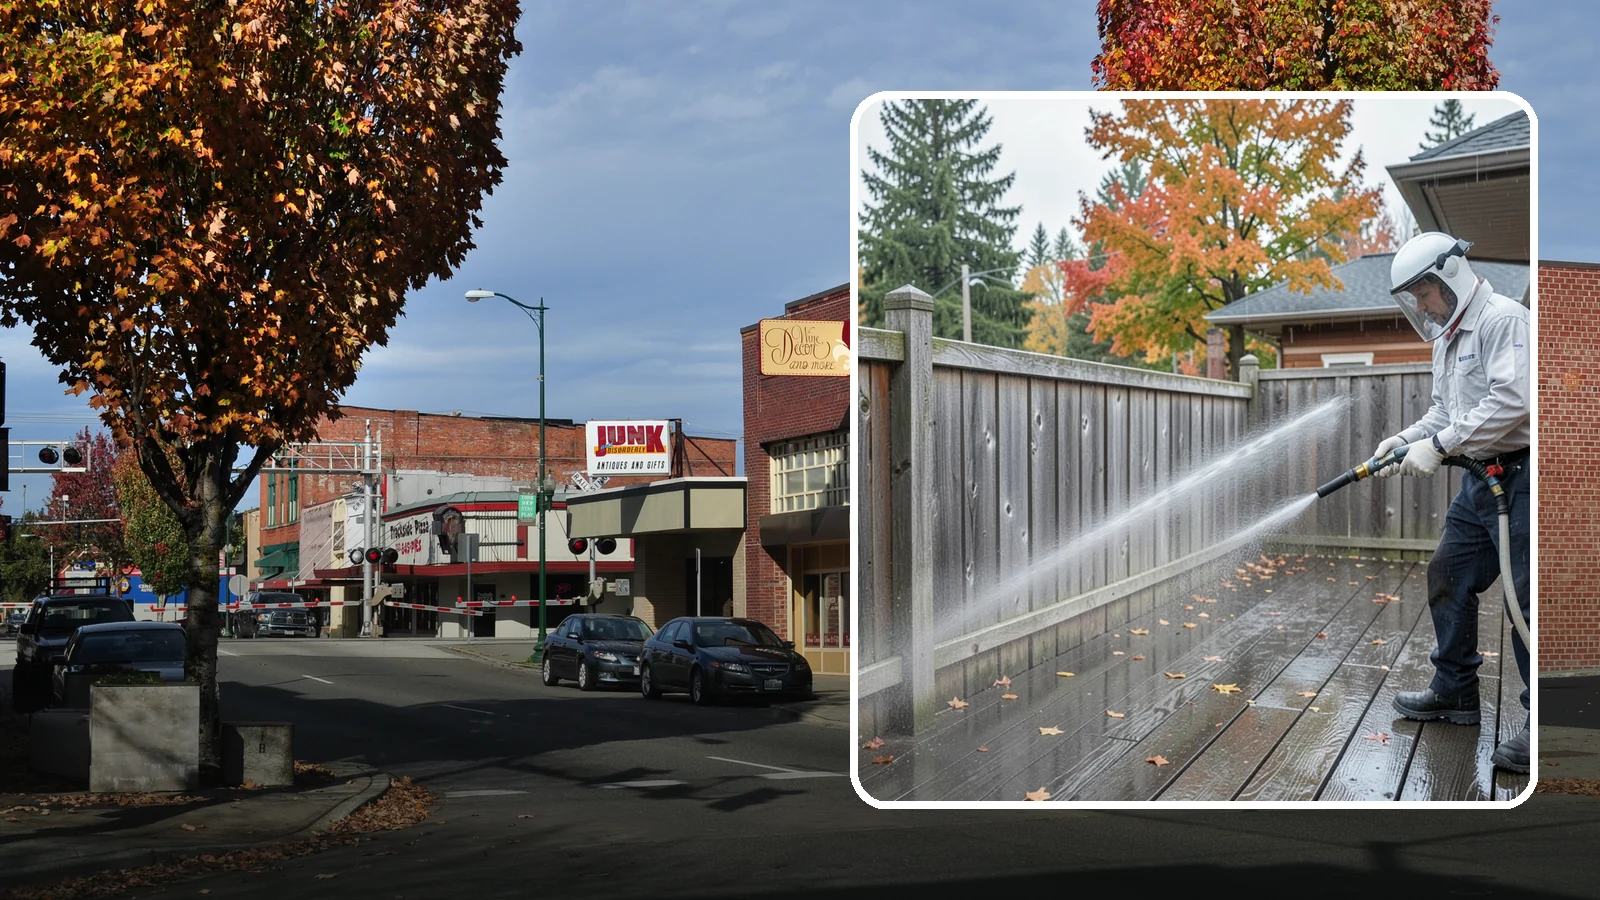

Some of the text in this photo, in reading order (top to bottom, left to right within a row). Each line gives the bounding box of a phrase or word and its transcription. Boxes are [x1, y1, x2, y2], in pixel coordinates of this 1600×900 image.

[595, 425, 665, 457] JUNK
[607, 446, 646, 454] DISORDERLY
[597, 460, 665, 470] ANTIQUES AND GIFTS
[390, 519, 429, 540] Trackside Pizza
